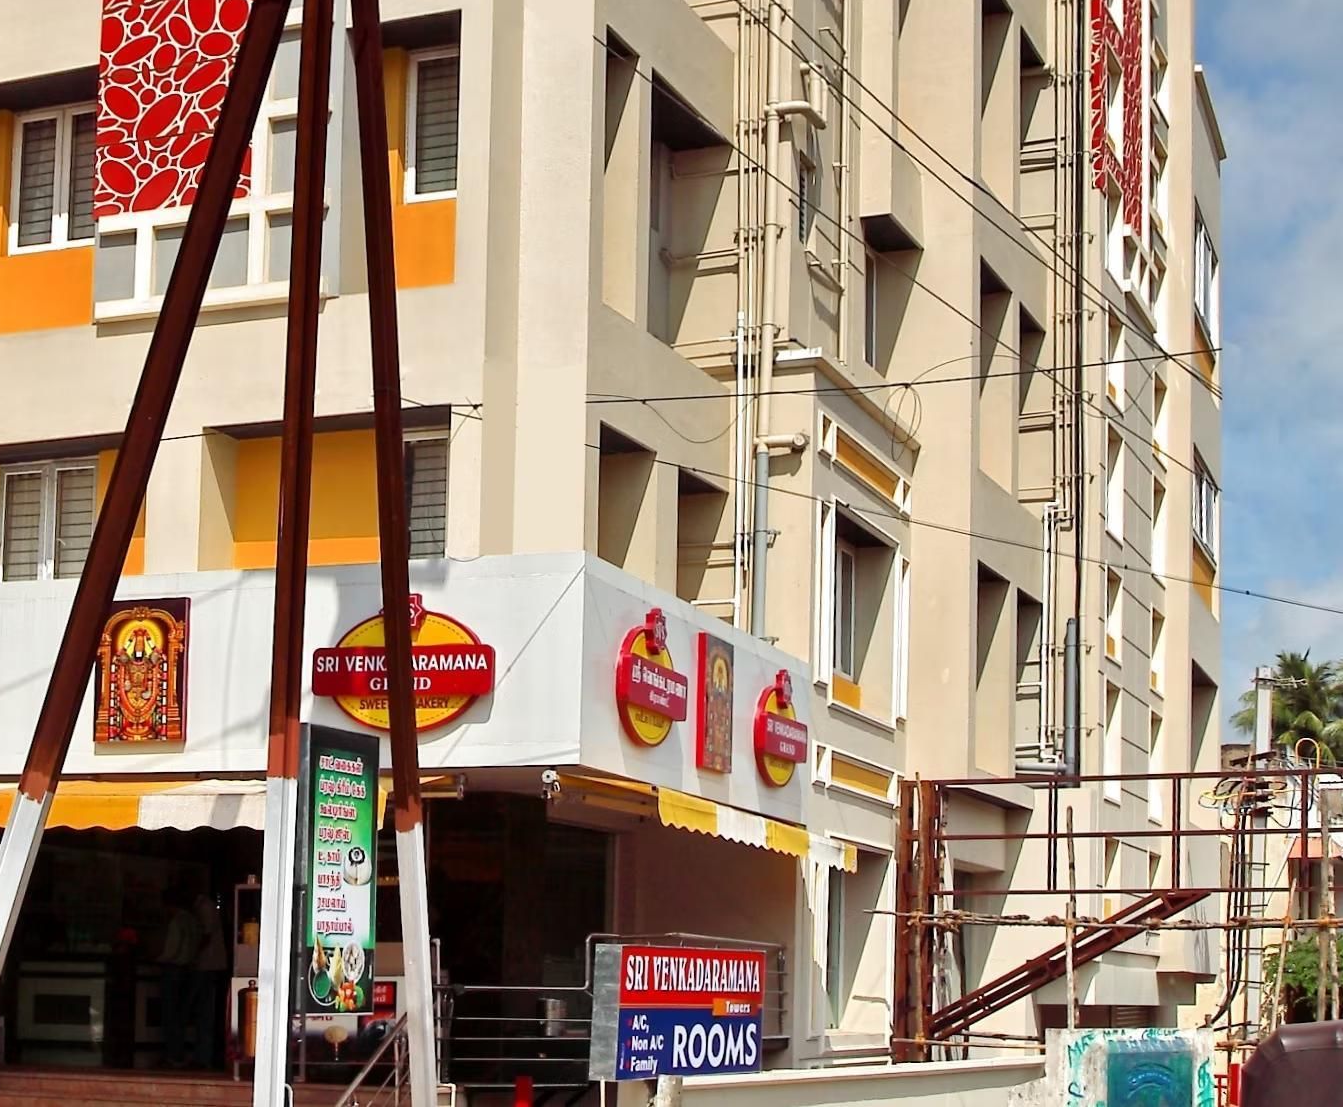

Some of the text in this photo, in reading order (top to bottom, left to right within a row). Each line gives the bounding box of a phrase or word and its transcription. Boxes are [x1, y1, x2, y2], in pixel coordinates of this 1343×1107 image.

[316, 653, 488, 673] SRI VENKARAMANA
[359, 697, 451, 710] SWEE AKERY
[625, 954, 760, 993] SRI VENKADARAMANA
[725, 1000, 750, 1014] Towers
[631, 1034, 665, 1051] Non A/C
[672, 1022, 757, 1069] ROOMS
[630, 1055, 658, 1075] Family
